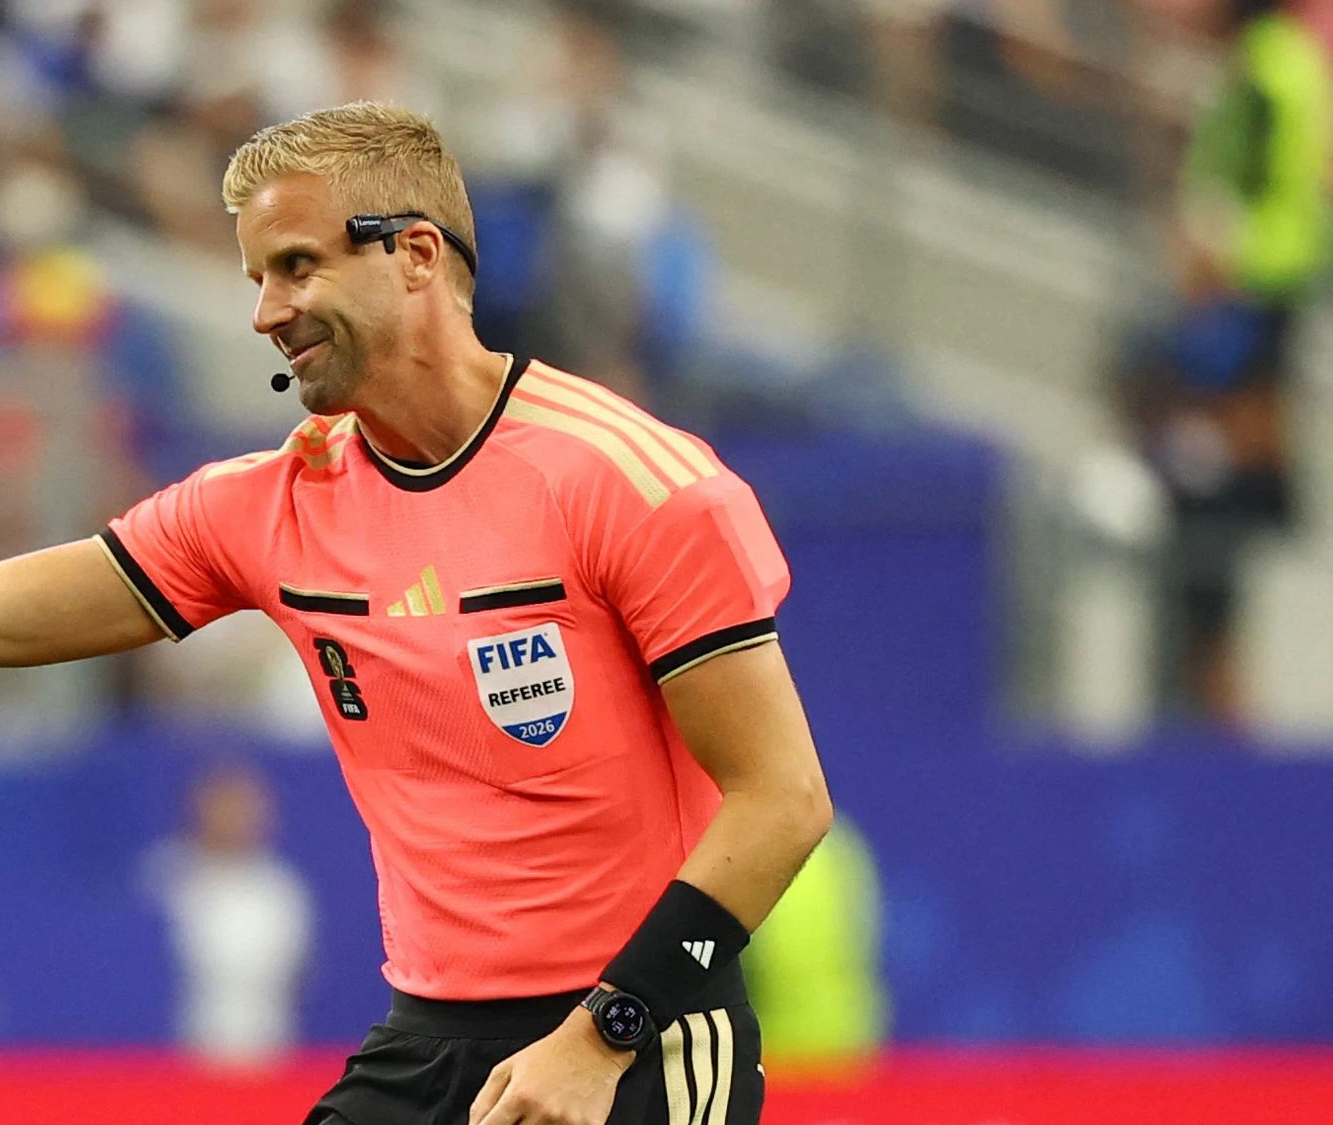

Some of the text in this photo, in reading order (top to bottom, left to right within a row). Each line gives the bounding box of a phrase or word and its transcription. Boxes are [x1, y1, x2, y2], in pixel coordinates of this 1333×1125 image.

[477, 634, 557, 674] FIFA
[488, 677, 566, 707] REFEREE
[342, 703, 361, 714] FIFA
[519, 720, 555, 739] 2026
